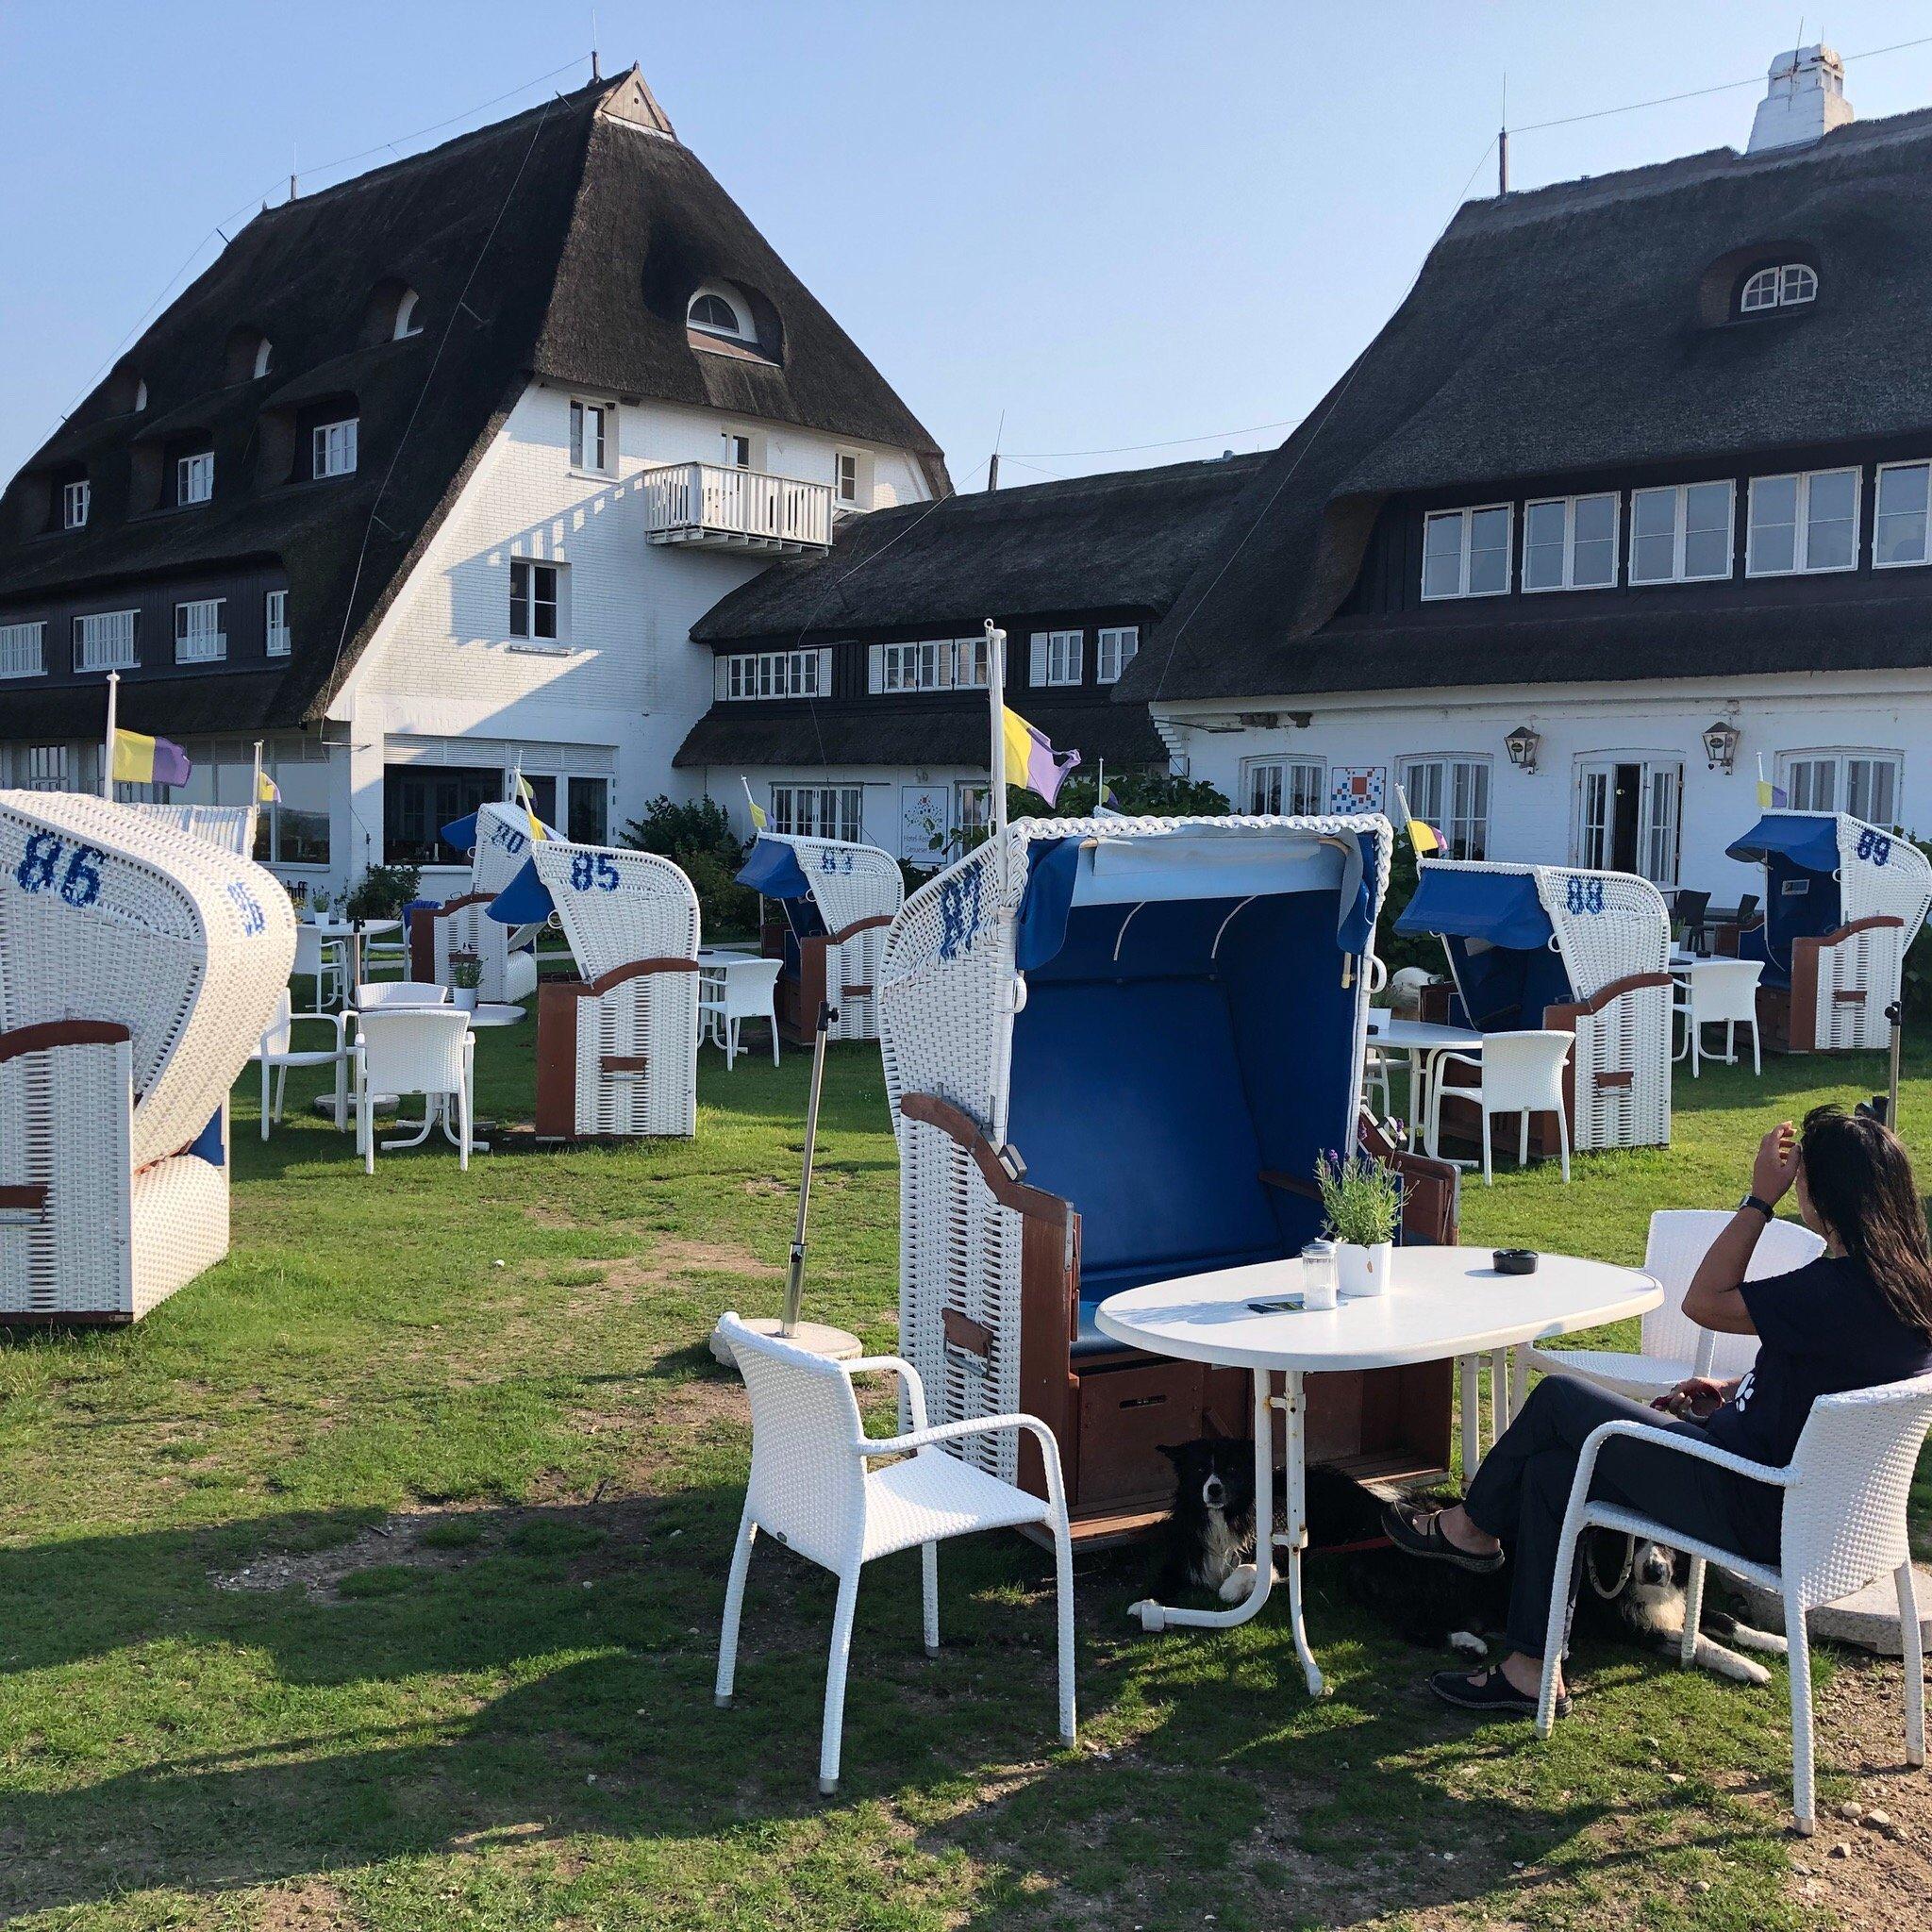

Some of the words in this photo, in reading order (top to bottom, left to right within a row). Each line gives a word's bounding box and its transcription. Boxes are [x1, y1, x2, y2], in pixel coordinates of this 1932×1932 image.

[1857, 828, 1890, 866] 89
[17, 831, 106, 907] 86
[570, 850, 620, 891] 85
[1567, 876, 1603, 915] 88
